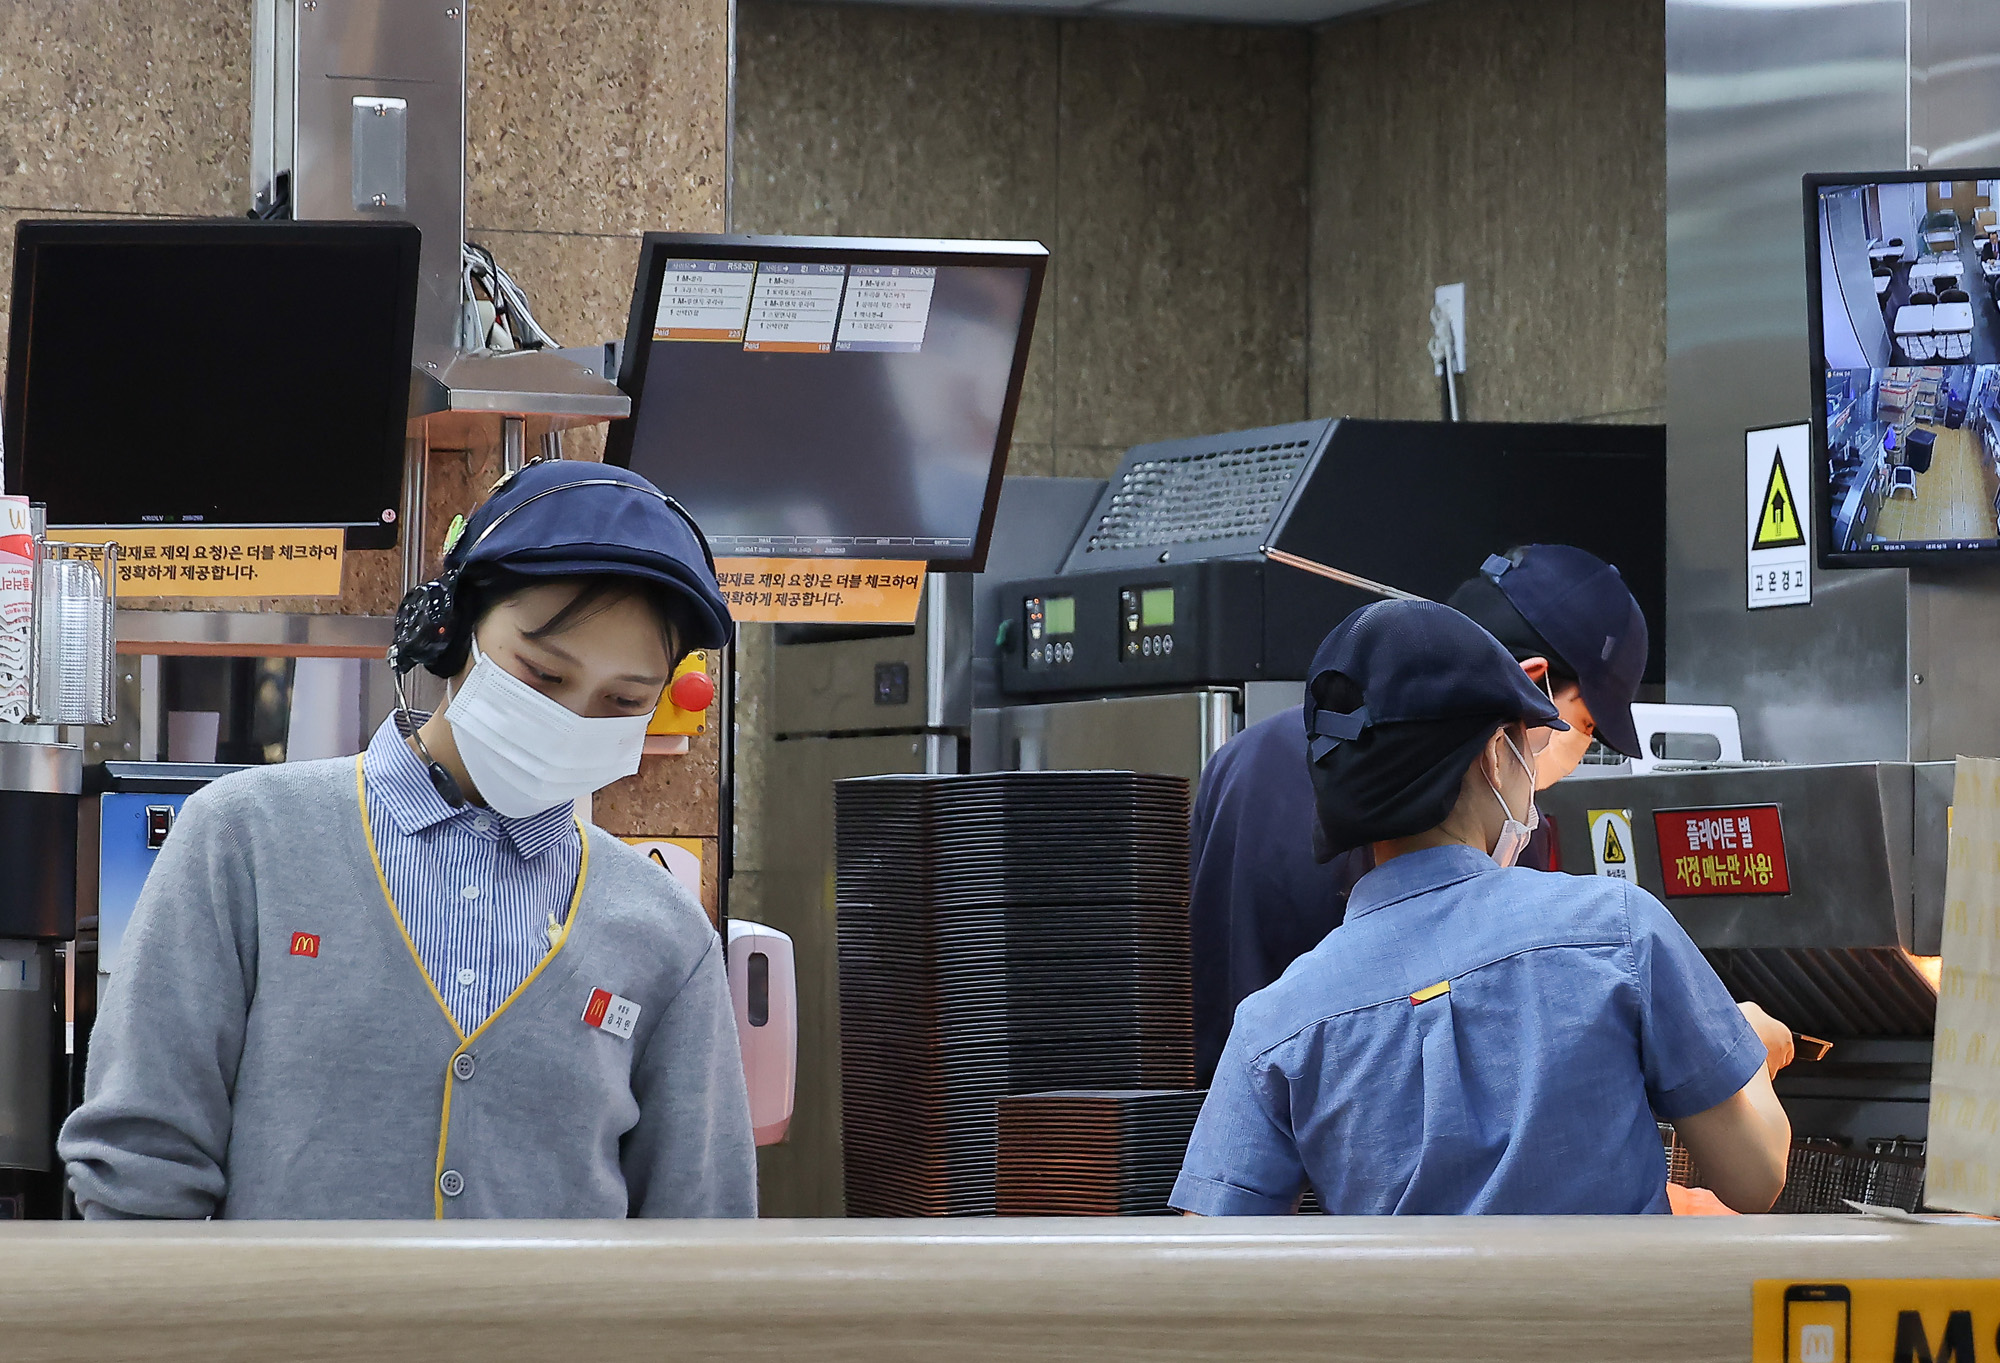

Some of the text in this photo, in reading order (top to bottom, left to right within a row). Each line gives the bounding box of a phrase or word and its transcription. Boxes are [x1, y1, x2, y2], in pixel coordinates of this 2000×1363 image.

[160, 544, 189, 561] 제외
[193, 544, 243, 561] 요청)은
[246, 545, 274, 561] 더블
[278, 544, 338, 561] 체크하여
[118, 564, 258, 581] 정확하게 제공합니다.
[758, 573, 785, 587] 제외
[788, 573, 833, 588] 요청)은
[836, 574, 862, 589] 더블
[865, 574, 918, 589] 체크하여
[774, 592, 844, 607] 제공합니다.
[1738, 815, 1753, 849] 별
[1675, 853, 1773, 887] 지정 메뉴만 사용!
[1894, 1309, 2000, 1363] M
